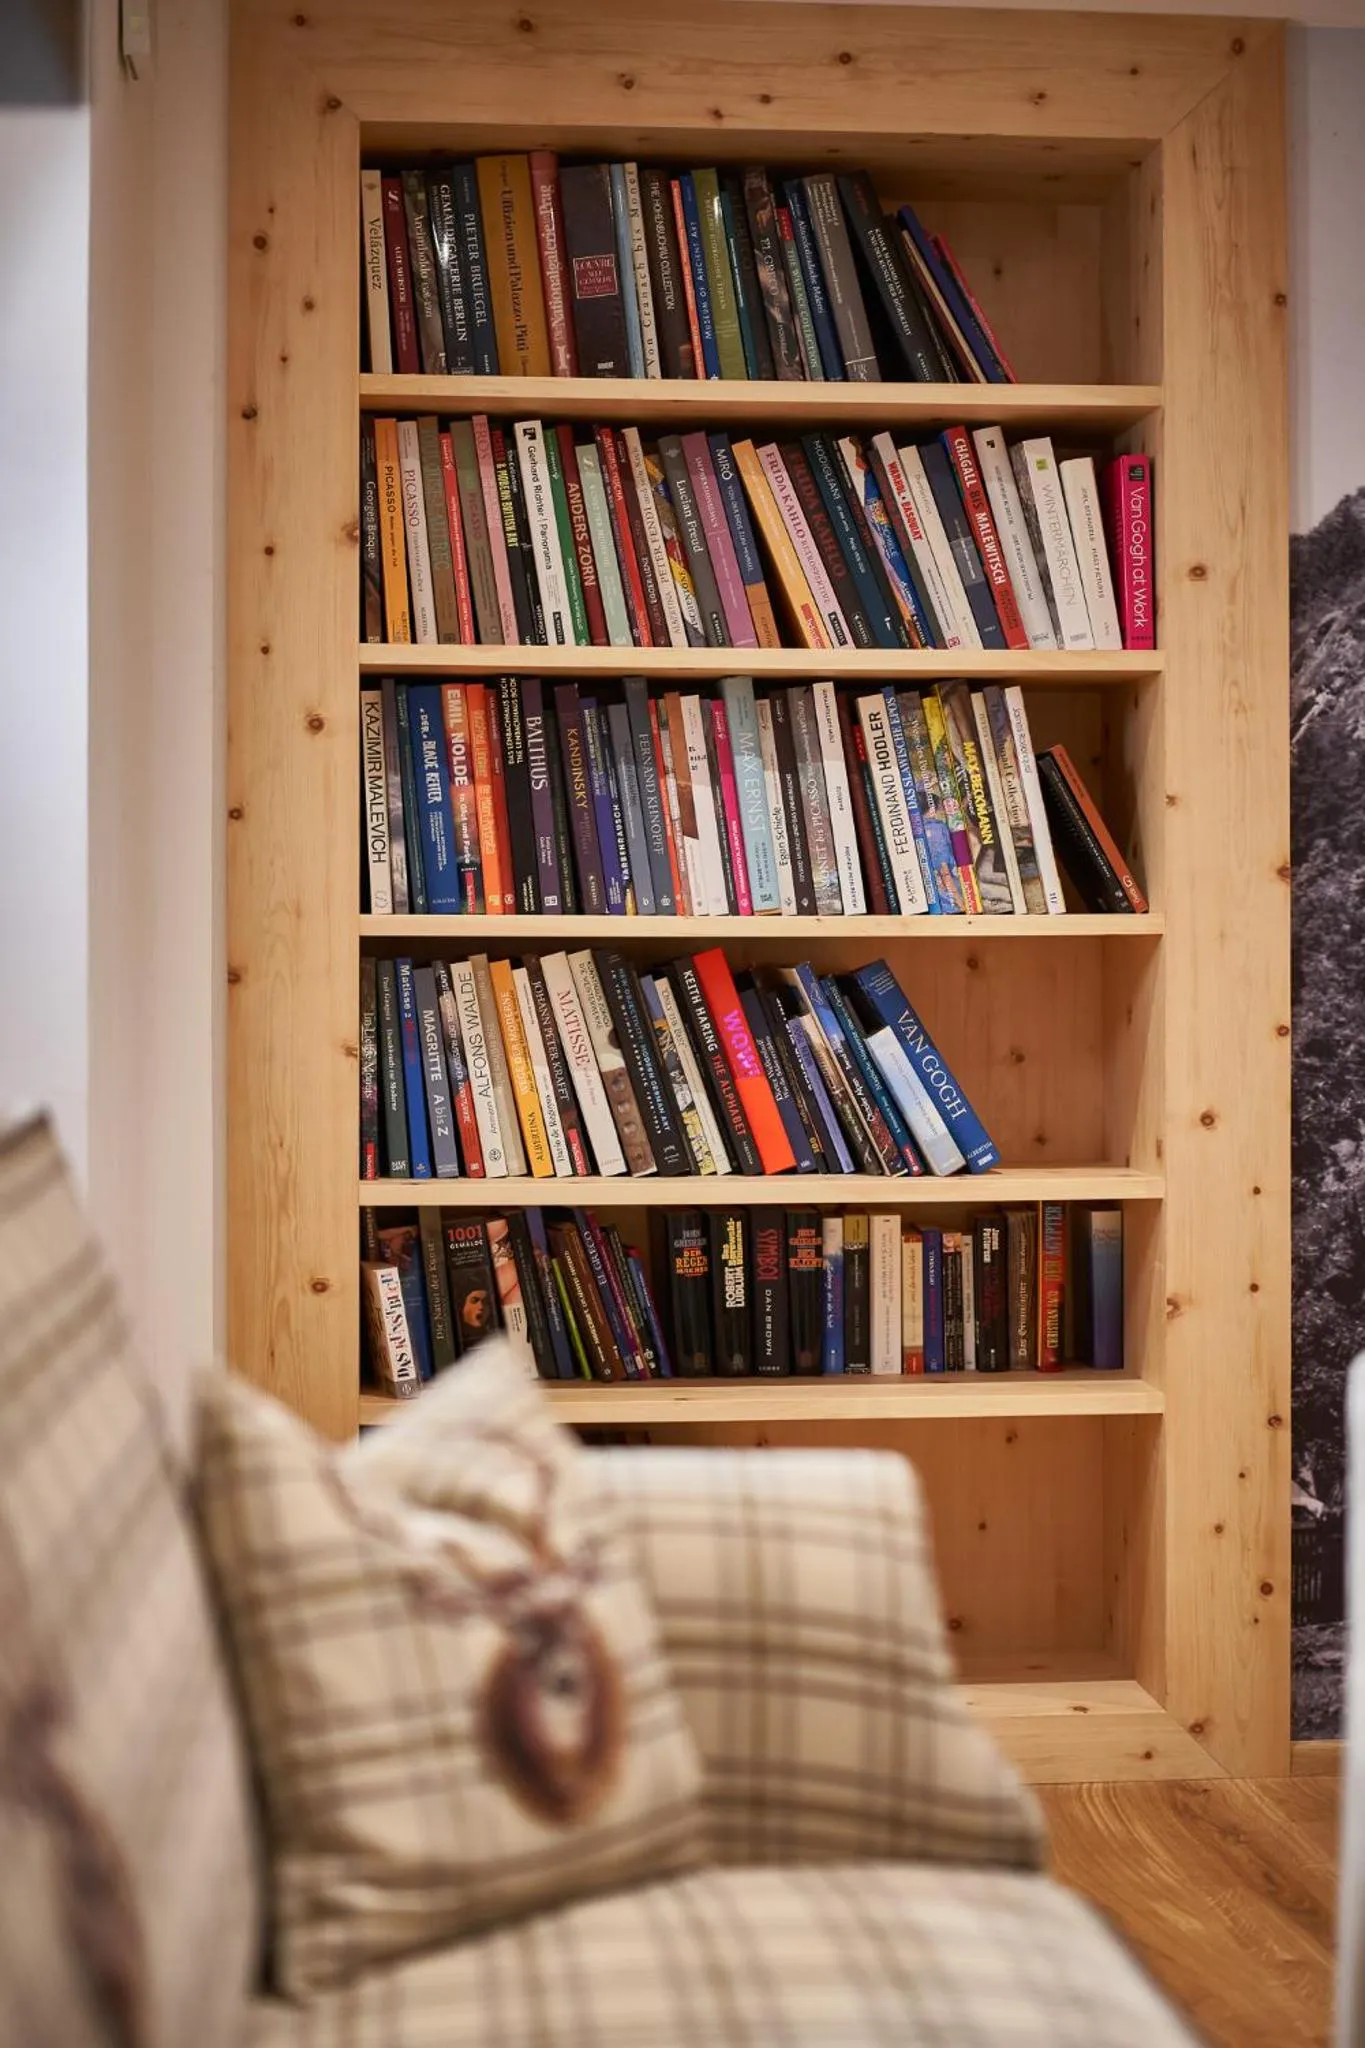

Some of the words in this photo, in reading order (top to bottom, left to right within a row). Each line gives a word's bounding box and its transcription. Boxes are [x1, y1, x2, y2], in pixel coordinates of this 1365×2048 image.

[368, 218, 382, 290] Velázquez
[464, 213, 479, 261] PIETER
[632, 229, 641, 251] bis
[453, 298, 467, 342] BERLIN
[509, 272, 525, 322] Palazzo
[637, 263, 651, 328] Cranach
[645, 338, 656, 367] Von
[716, 448, 732, 480] MIRÓ
[364, 481, 376, 522] Georges
[385, 466, 396, 513] PICASSO
[405, 469, 420, 527] PICASSO
[527, 446, 539, 482] Gerhard
[533, 485, 545, 516] Richter
[539, 524, 553, 570] Panorama
[766, 452, 787, 492] FRIDA
[783, 494, 806, 539] KAHLO
[954, 438, 977, 487] CHAGALL
[975, 512, 1006, 584] MALEWITSCH
[1130, 487, 1145, 518] Van
[366, 525, 376, 558] Braque
[506, 532, 518, 547] ART
[568, 483, 586, 540] ANDERS
[579, 545, 595, 587] ZORN
[644, 507, 659, 543] FENDI
[676, 480, 694, 518] Lucian
[685, 521, 703, 553] Freud
[653, 546, 669, 584] PETER
[815, 513, 846, 578] KAHLO
[1126, 520, 1146, 565] Gogh
[1132, 568, 1146, 585] at
[1133, 589, 1148, 628] Work
[447, 689, 461, 728] EMIL
[886, 697, 899, 725] EPOS
[365, 702, 381, 773] KAZIMIR
[451, 732, 468, 787] NOLDE
[526, 716, 548, 790] BALTHUS
[738, 732, 757, 774] MAX
[868, 712, 891, 771] HODLER
[893, 728, 914, 787] SLAWISCHE
[567, 729, 588, 808] KANDINSKY
[639, 734, 657, 793] FERNAND
[369, 775, 386, 863] MALEVICH
[747, 777, 765, 833] ERNST
[807, 778, 824, 826] PICASSO
[882, 774, 909, 855] FERDINAND
[906, 789, 918, 809] DAS
[969, 773, 994, 844] BECKMANN
[1005, 772, 1022, 827] Collection
[778, 842, 788, 866] Egon
[400, 965, 412, 1009] Matisse
[458, 972, 479, 1030] WALDE
[423, 1010, 442, 1081] MAGRITTE
[532, 981, 549, 1024] JOHANN
[542, 1027, 558, 1060] PETER
[552, 1062, 570, 1101] KRAFFT
[557, 991, 590, 1066] MATISSE
[683, 971, 701, 1004] KEITH
[696, 1008, 717, 1052] HARING
[712, 1054, 724, 1076] THE
[719, 1081, 743, 1136] ALPHABET
[467, 1034, 491, 1098] ALFONS
[897, 1010, 929, 1053] VAN
[921, 1056, 968, 1120] GOGH
[433, 1095, 445, 1105] A
[436, 1107, 447, 1125] bis
[437, 1126, 448, 1136] Z
[448, 1224, 482, 1241] 1001
[725, 1267, 735, 1308] ROBERT
[734, 1266, 745, 1308] LUDLUM
